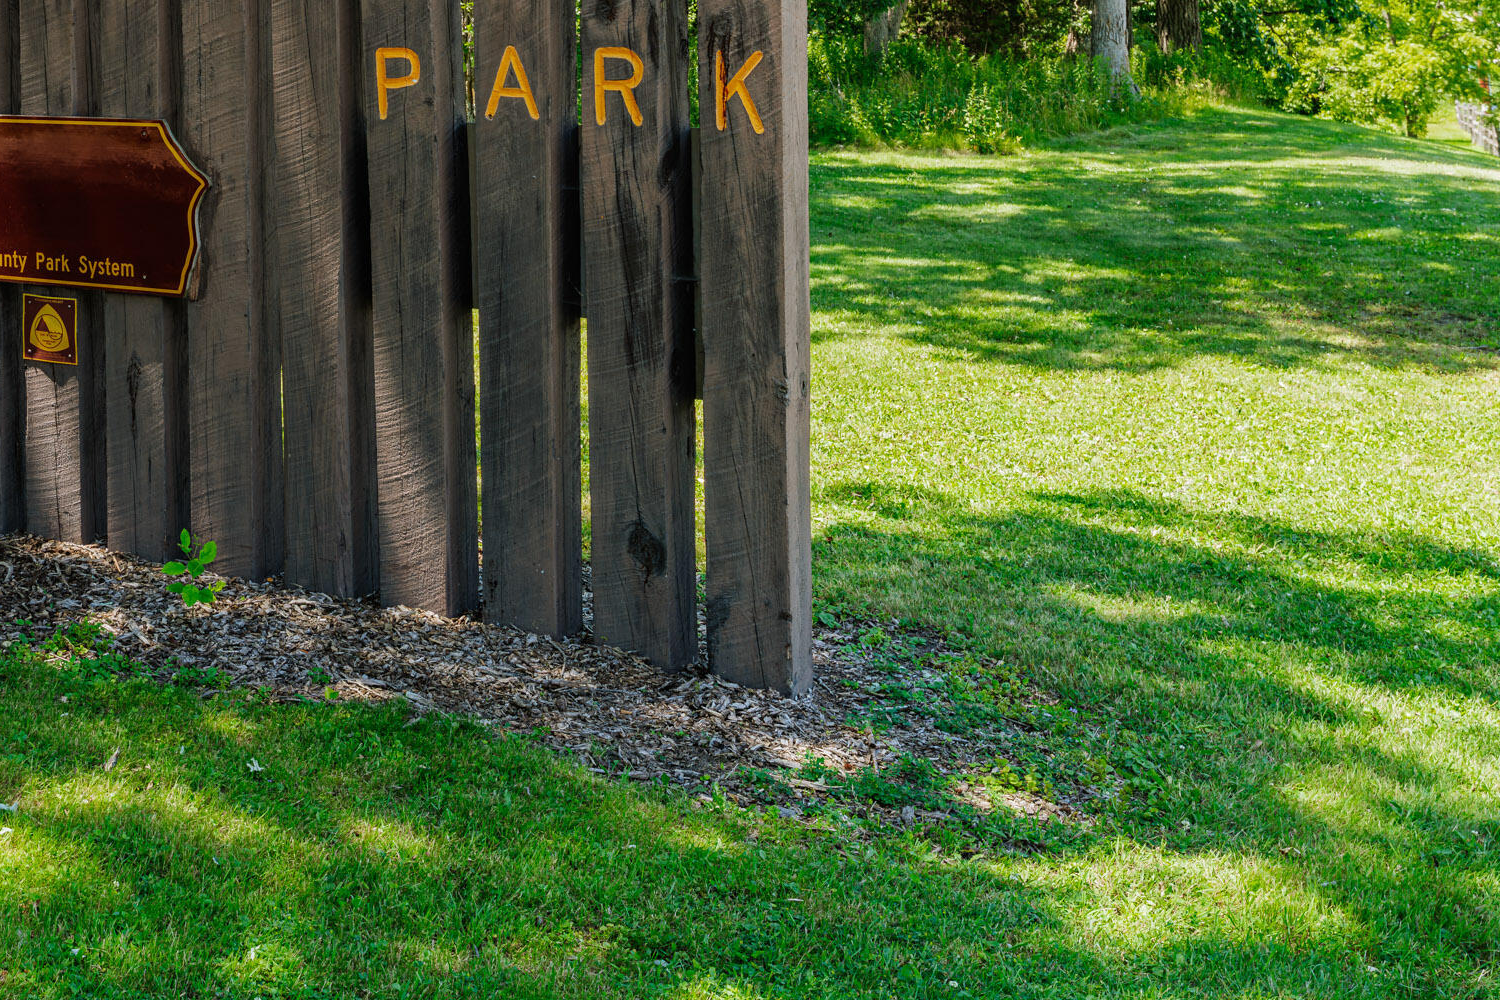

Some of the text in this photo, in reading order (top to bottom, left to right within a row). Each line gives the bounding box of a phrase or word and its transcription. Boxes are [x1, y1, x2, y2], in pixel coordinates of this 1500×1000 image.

[374, 44, 766, 135] PARK
[35, 251, 71, 274] Park
[78, 255, 136, 279] System
